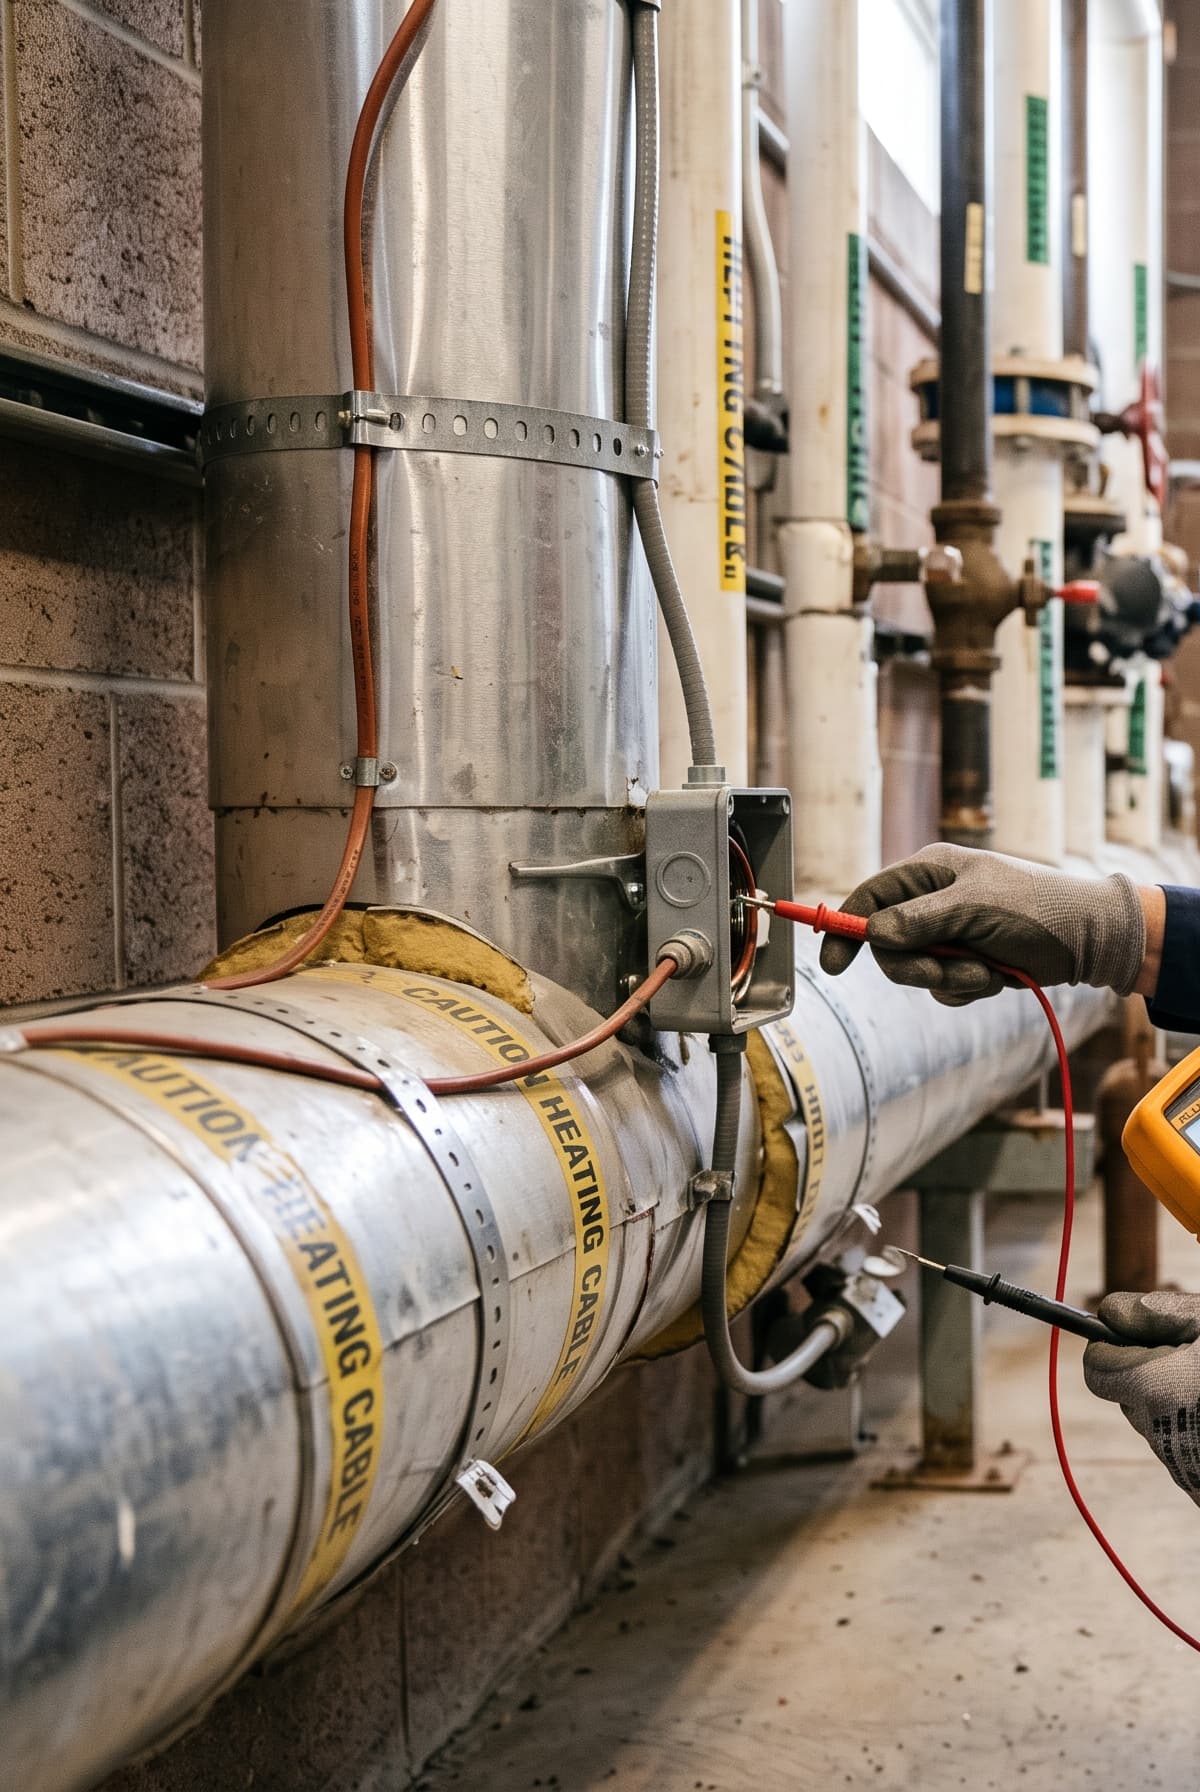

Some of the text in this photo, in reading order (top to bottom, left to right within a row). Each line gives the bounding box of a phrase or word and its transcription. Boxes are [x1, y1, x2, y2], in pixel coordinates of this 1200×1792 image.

[540, 1096, 603, 1253] HEATING
[88, 1053, 268, 1163] AUTION
[326, 1388, 374, 1544] CABLE
[556, 1265, 601, 1386] CABLE
